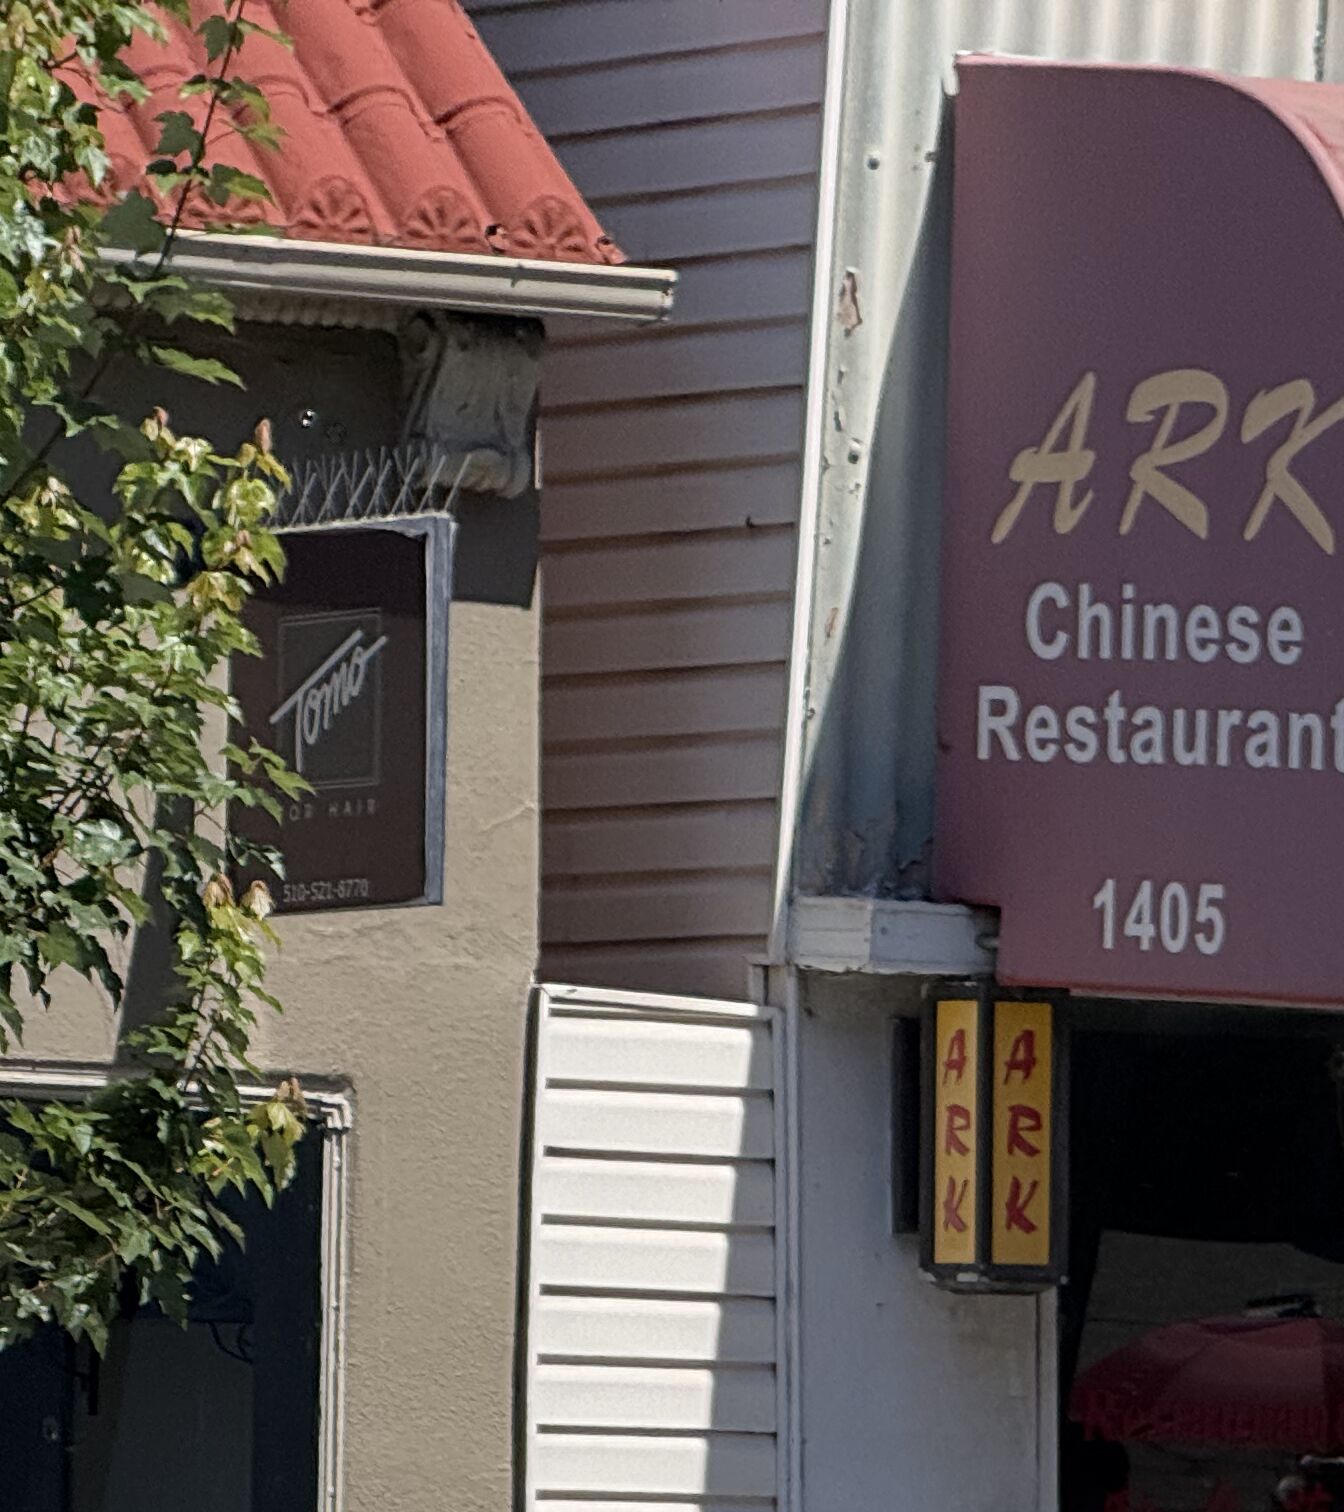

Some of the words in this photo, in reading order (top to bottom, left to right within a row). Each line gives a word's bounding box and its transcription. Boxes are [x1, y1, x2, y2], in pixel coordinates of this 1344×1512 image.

[1025, 582, 1306, 665] Chinese
[268, 627, 389, 775] Tomo
[1092, 878, 1227, 955] 1405
[943, 1027, 972, 1234] ARK
[1003, 1028, 1043, 1235] ARK
